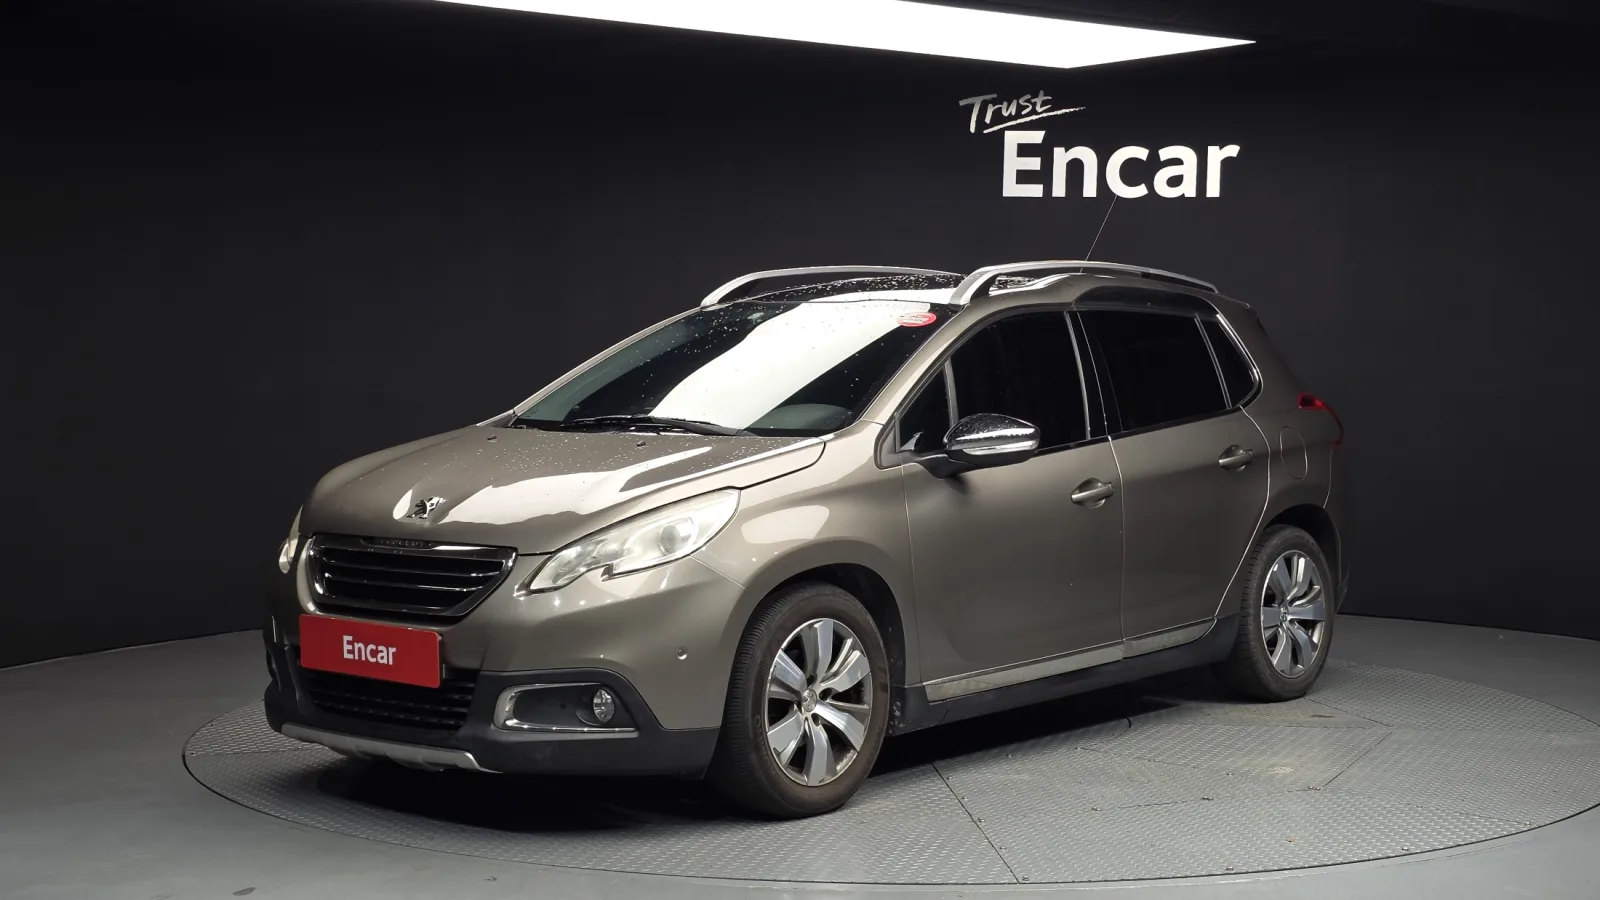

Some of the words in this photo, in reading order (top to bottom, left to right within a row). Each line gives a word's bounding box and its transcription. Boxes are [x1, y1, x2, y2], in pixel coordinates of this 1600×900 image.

[959, 90, 1054, 134] Trust
[1002, 130, 1241, 199] Encar
[342, 635, 396, 665] Encar
